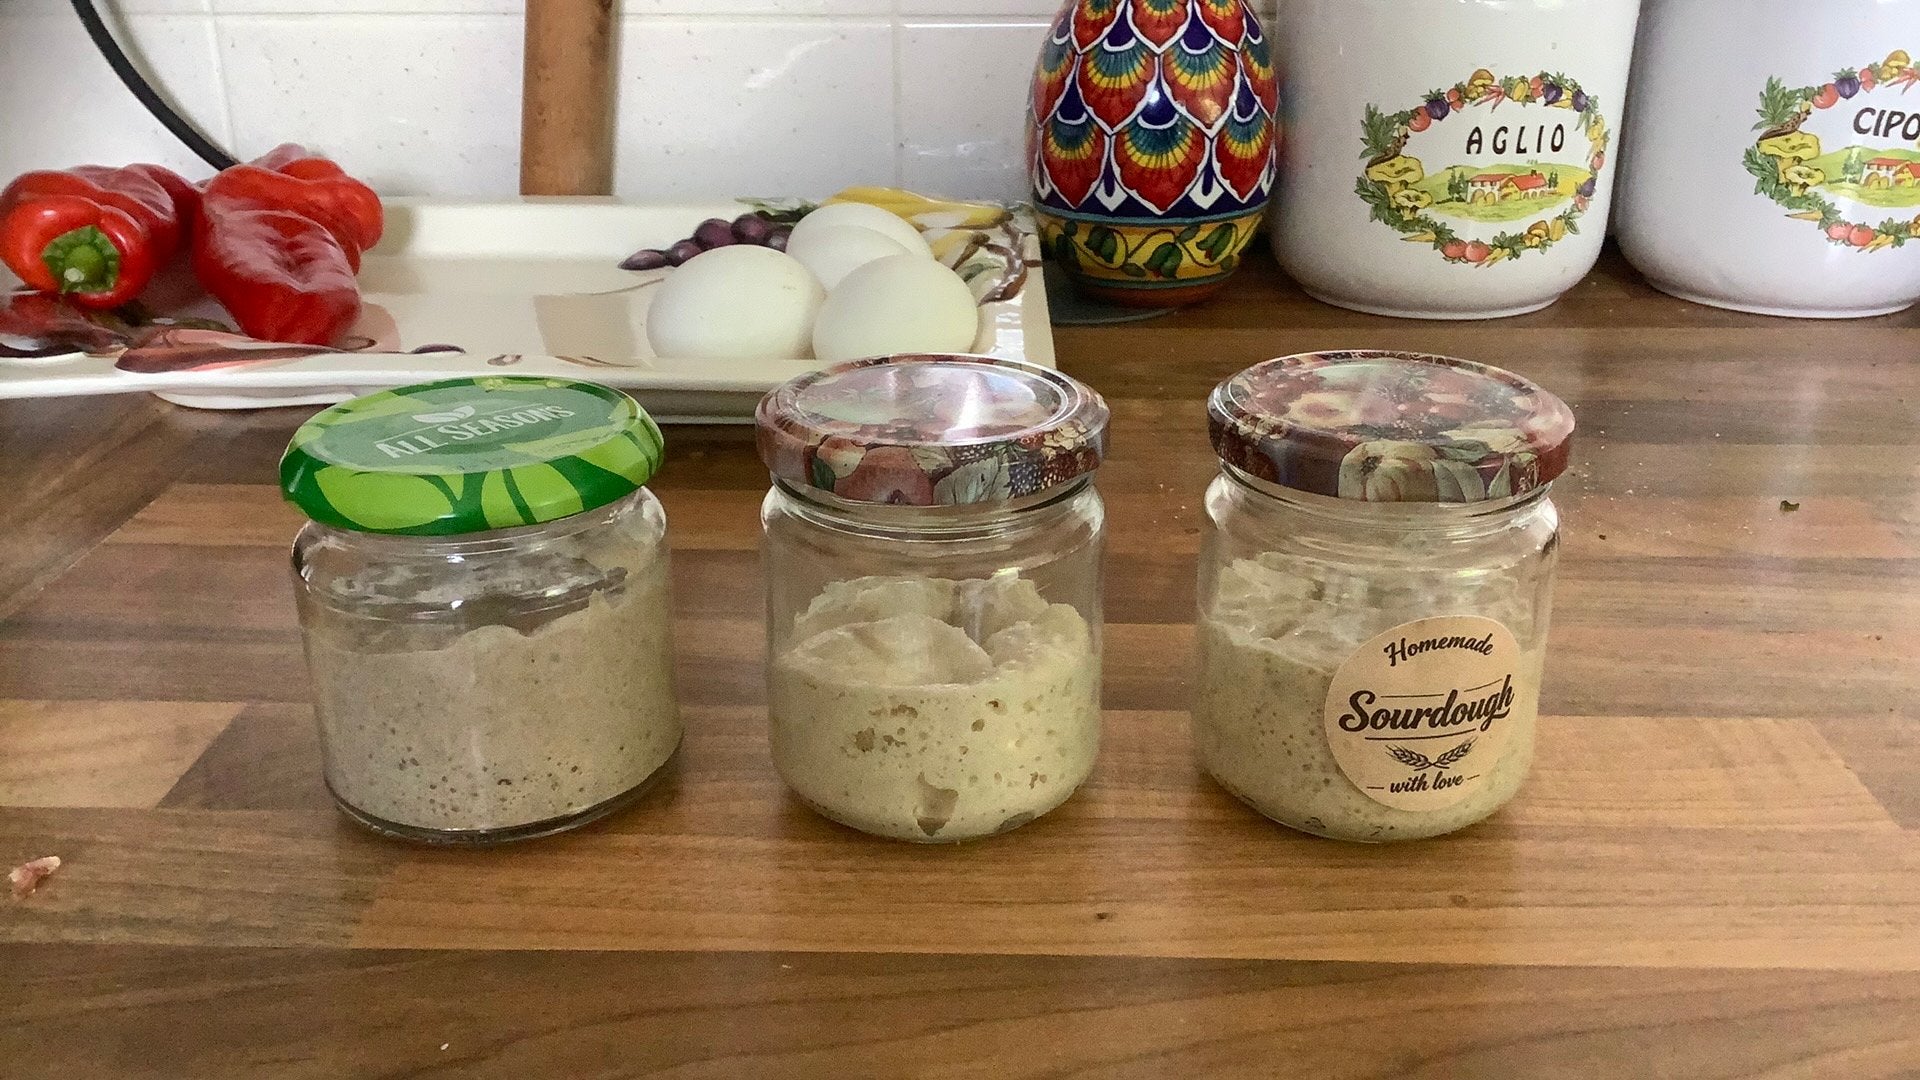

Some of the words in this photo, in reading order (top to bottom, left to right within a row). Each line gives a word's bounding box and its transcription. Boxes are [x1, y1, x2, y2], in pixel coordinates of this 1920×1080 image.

[1466, 123, 1565, 155] AGLIO
[1853, 107, 1920, 140] CIPO
[375, 435, 448, 459] ALL
[437, 404, 576, 441] SEASONS
[1383, 633, 1493, 667] Homemade
[1338, 673, 1515, 732] Sourdough
[1389, 774, 1429, 793] with
[1432, 770, 1464, 790] love
